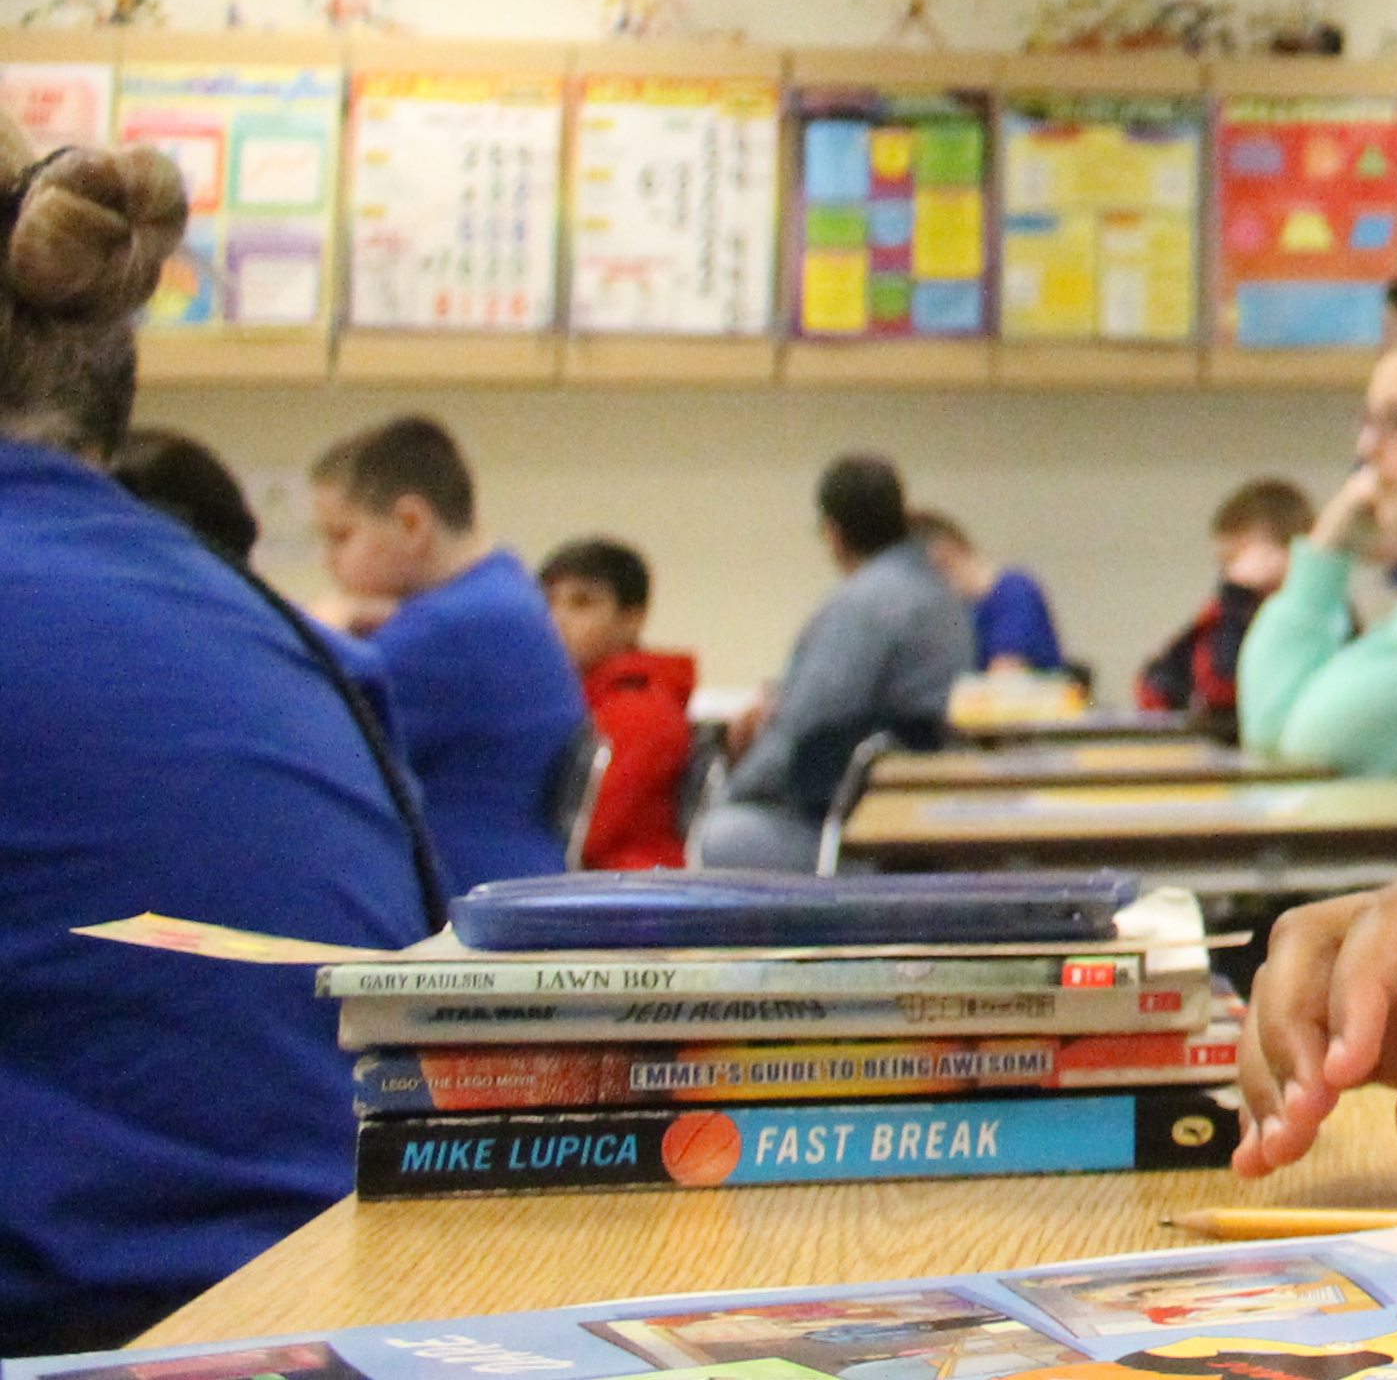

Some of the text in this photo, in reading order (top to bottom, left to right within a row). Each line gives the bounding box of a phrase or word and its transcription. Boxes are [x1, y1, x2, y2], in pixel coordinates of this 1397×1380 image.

[360, 972, 496, 990] GARY PAULSEN
[535, 969, 677, 990] LAWN BOY
[615, 1002, 686, 1023] JEDI
[631, 1052, 1048, 1088] EMMET'S GUIDE TO BEING AWESOME
[380, 1076, 418, 1092] LEGO
[456, 1074, 493, 1088] LEGO
[401, 1133, 638, 1172] MIKE LUPICA
[755, 1118, 1000, 1166] FAST BREAK
